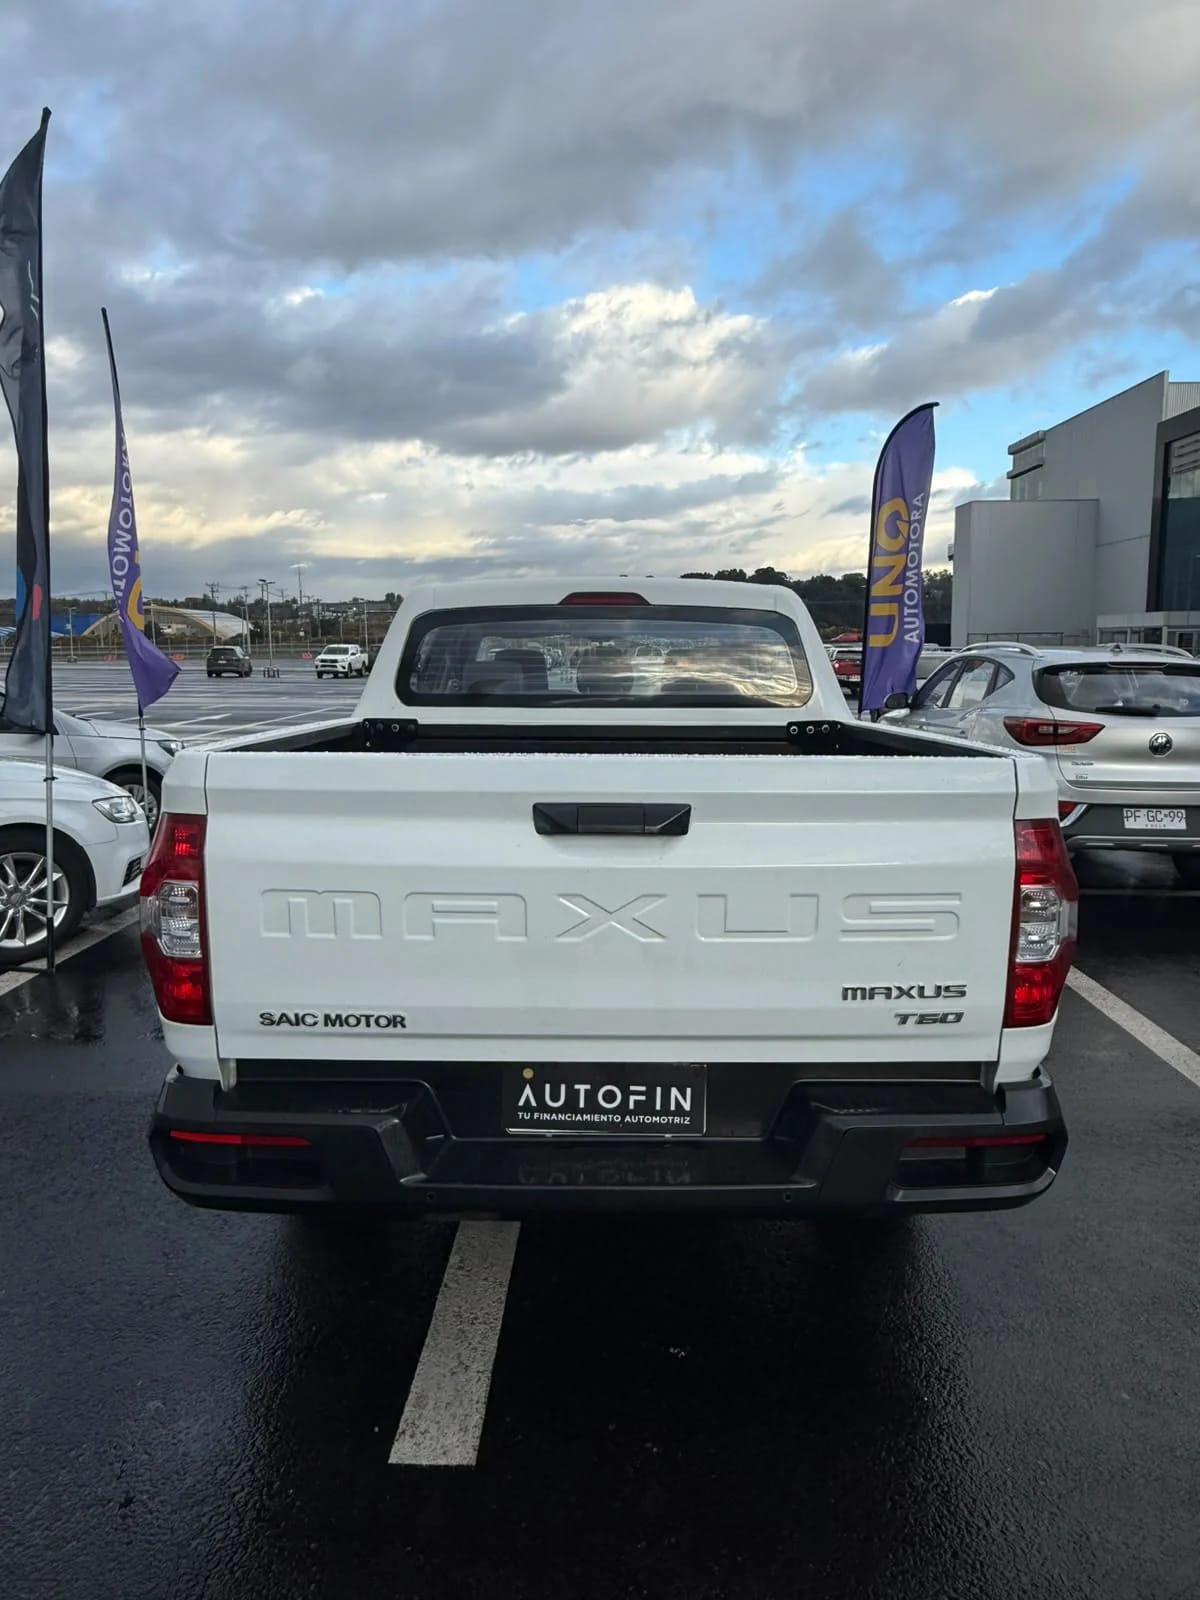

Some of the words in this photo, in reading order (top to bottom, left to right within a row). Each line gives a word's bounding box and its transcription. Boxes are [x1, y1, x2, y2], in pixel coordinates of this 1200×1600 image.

[868, 497, 910, 648] UNO
[903, 492, 925, 644] AUTOMOTORA
[260, 888, 963, 943] MAXUS
[841, 983, 968, 1001] MAXUS
[259, 1011, 319, 1028] SAIC
[323, 1013, 407, 1029] MOTOR
[894, 1011, 965, 1026] T60
[517, 1083, 692, 1112] AUTOFIN
[518, 1111, 531, 1121] TU
[533, 1112, 621, 1123] FINANCIAMIENTO
[624, 1115, 691, 1125] AUTOMOTRIZ
